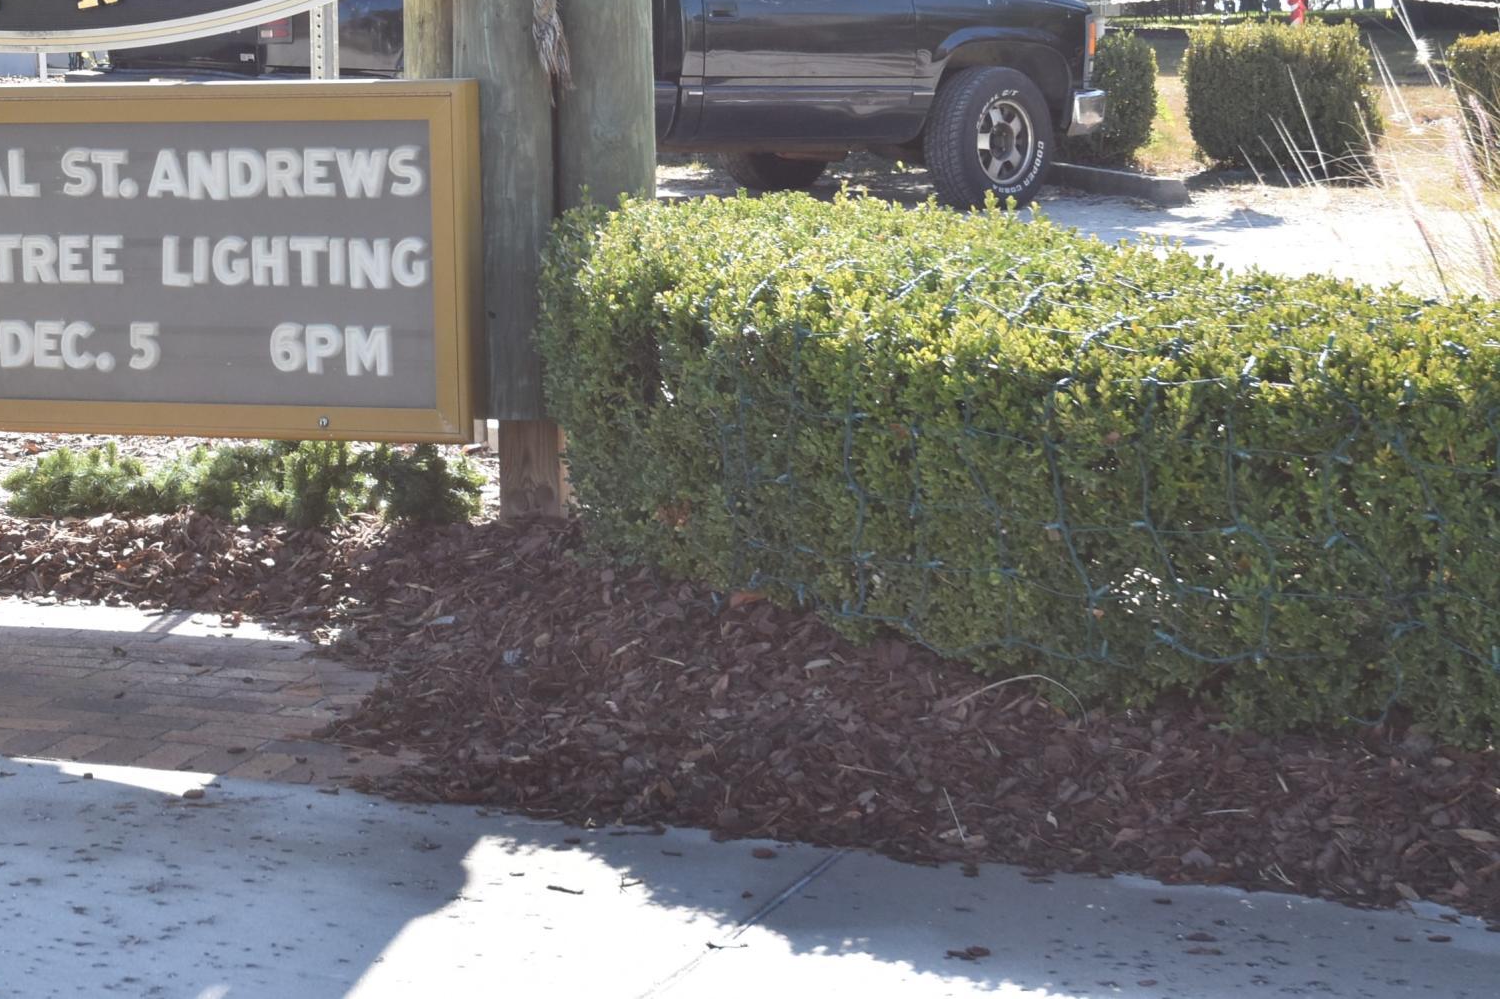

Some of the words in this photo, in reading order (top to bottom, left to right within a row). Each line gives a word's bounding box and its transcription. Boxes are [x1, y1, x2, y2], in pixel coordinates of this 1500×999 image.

[147, 145, 423, 200] ANDREWS
[1023, 140, 1045, 187] COOPER
[161, 235, 430, 289] LIGHTING
[0, 320, 116, 374] DEC.
[128, 321, 162, 371] 5
[269, 322, 393, 377] 6PM
